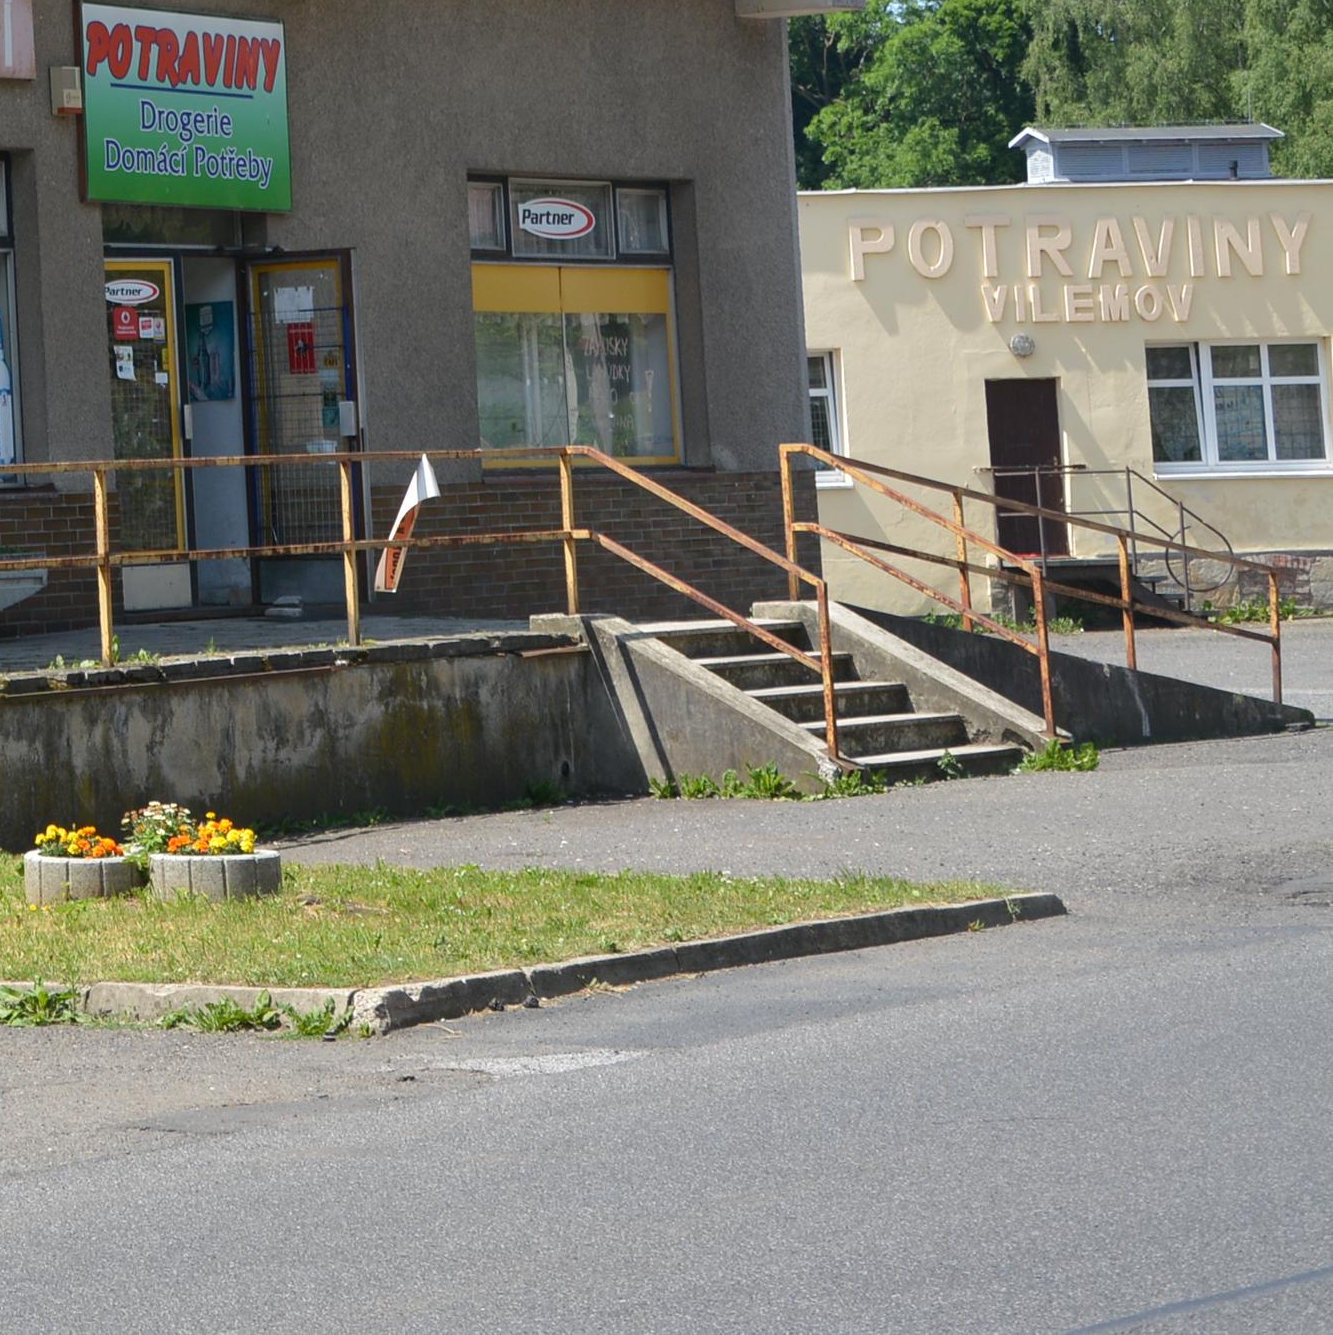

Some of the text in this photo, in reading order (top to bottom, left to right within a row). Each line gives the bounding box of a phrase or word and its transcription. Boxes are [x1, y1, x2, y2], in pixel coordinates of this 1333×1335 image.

[86, 21, 281, 93] POTRAVINY
[140, 99, 232, 142] Drogerie
[104, 138, 272, 189] Domácí Potřeby
[521, 209, 575, 226] Partner
[848, 212, 1312, 281] POTRAVINY
[981, 283, 1194, 323] VILEMOV
